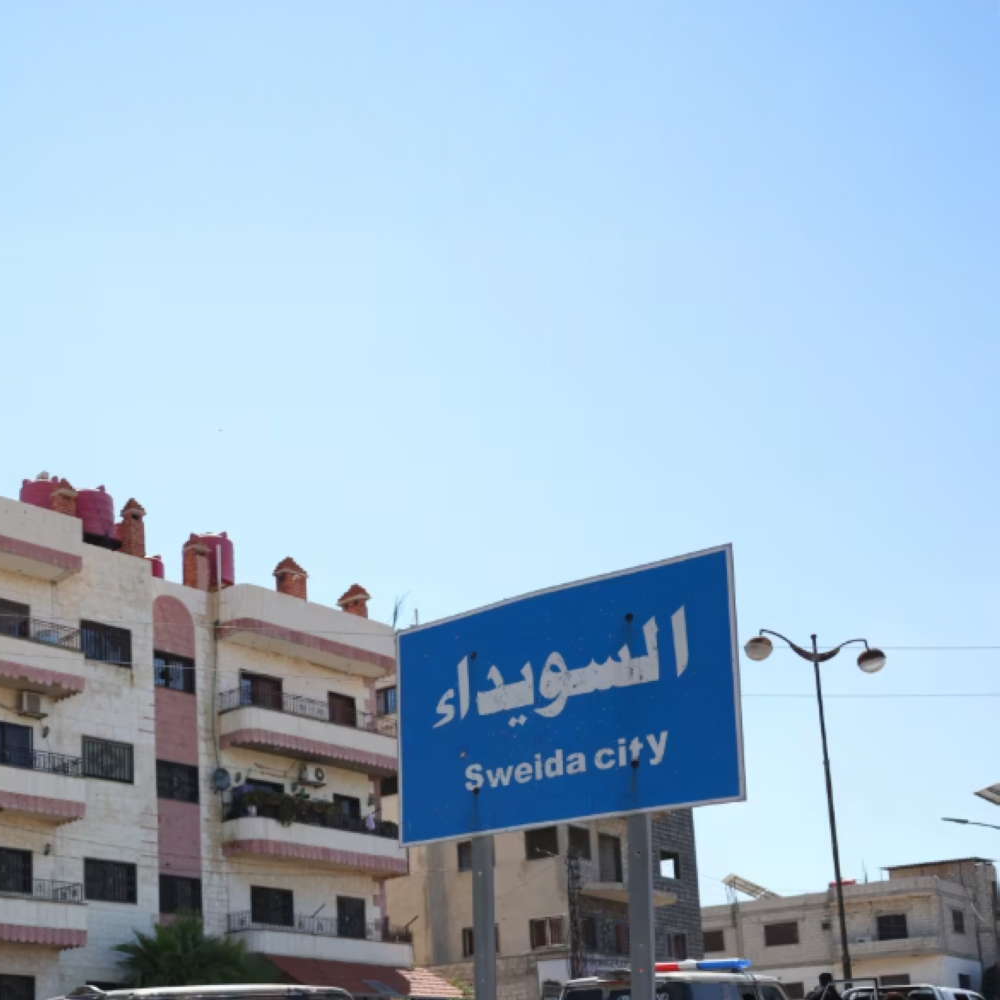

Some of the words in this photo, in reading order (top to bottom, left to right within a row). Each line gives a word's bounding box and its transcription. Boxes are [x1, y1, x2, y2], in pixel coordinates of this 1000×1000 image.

[433, 605, 689, 728] السويداء
[466, 749, 587, 791] Sweida
[594, 731, 669, 768] city
